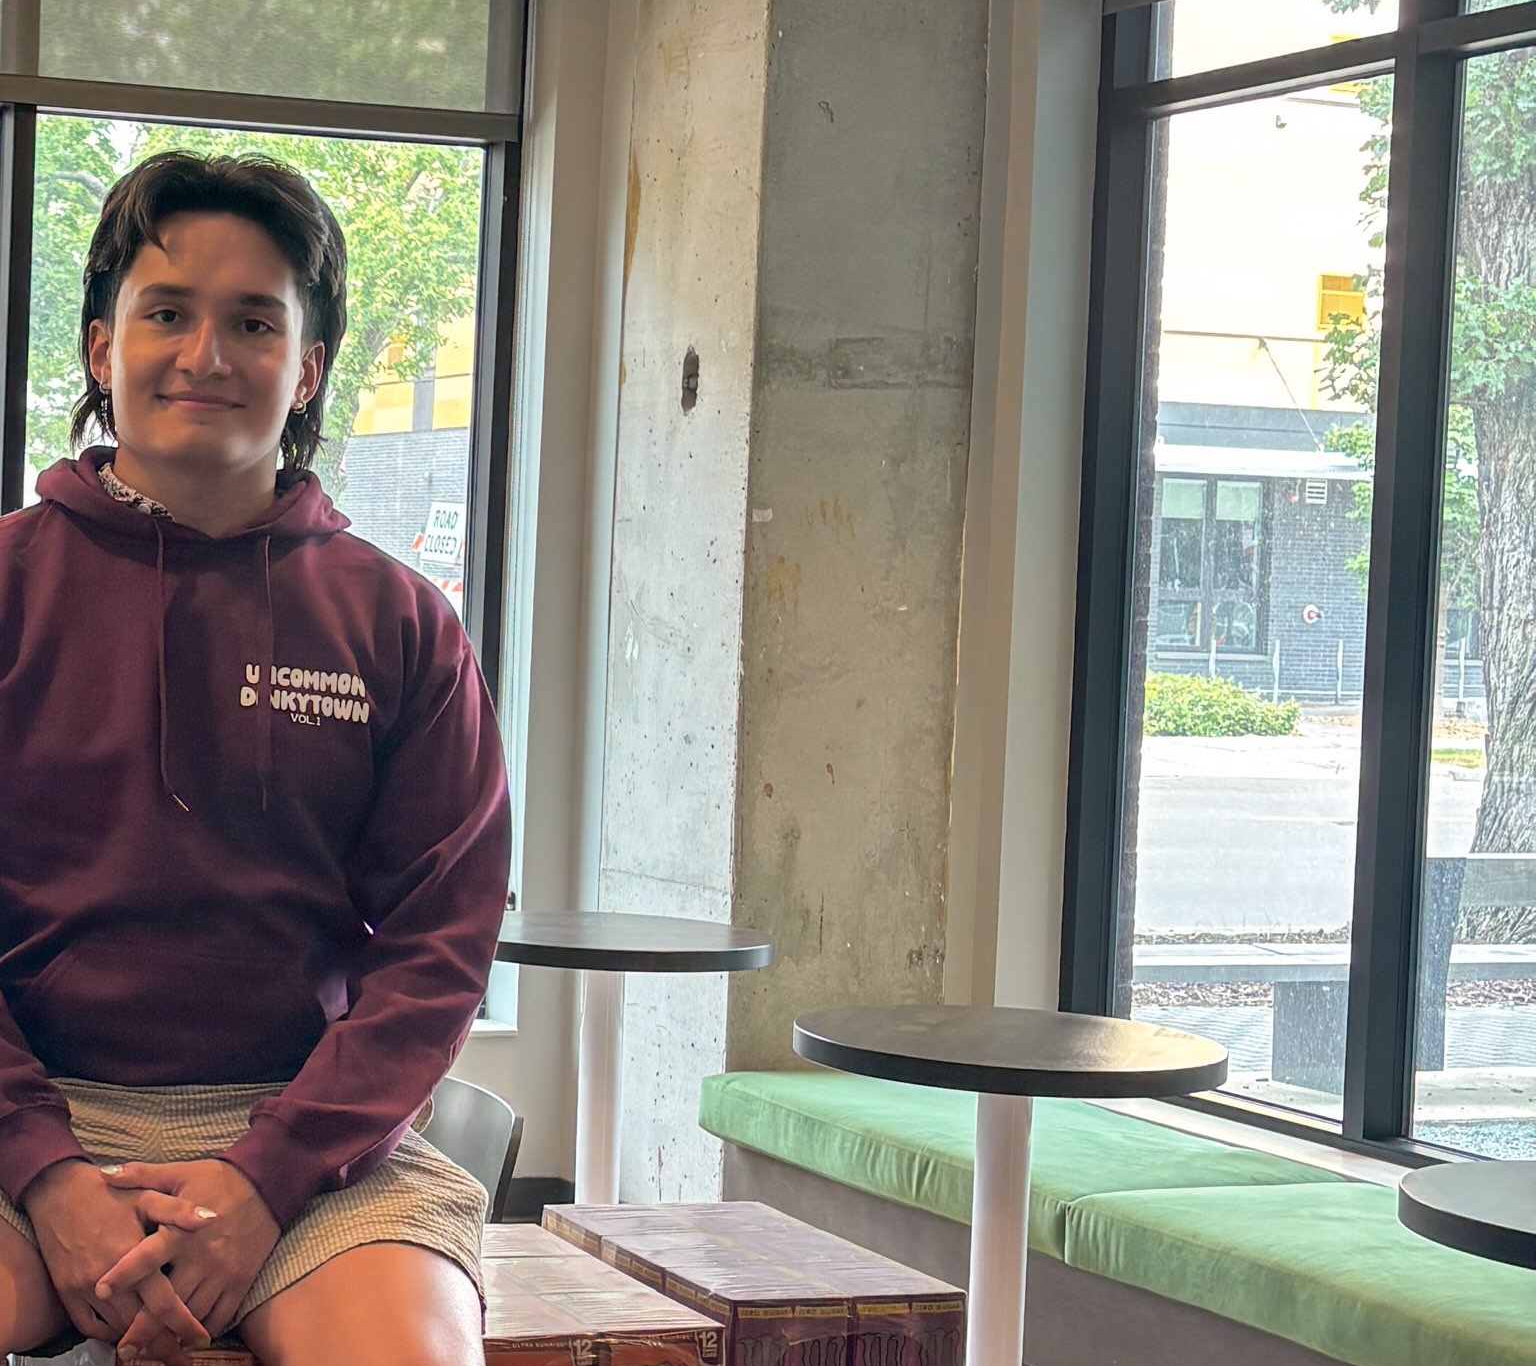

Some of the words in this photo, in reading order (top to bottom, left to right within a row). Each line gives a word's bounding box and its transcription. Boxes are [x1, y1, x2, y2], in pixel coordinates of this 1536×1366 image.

[433, 510, 458, 529] ROAD
[424, 535, 457, 555] CLOSED
[240, 686, 370, 724] DNKYTOWN
[575, 1339, 592, 1355] 12
[700, 1331, 718, 1348] 12
